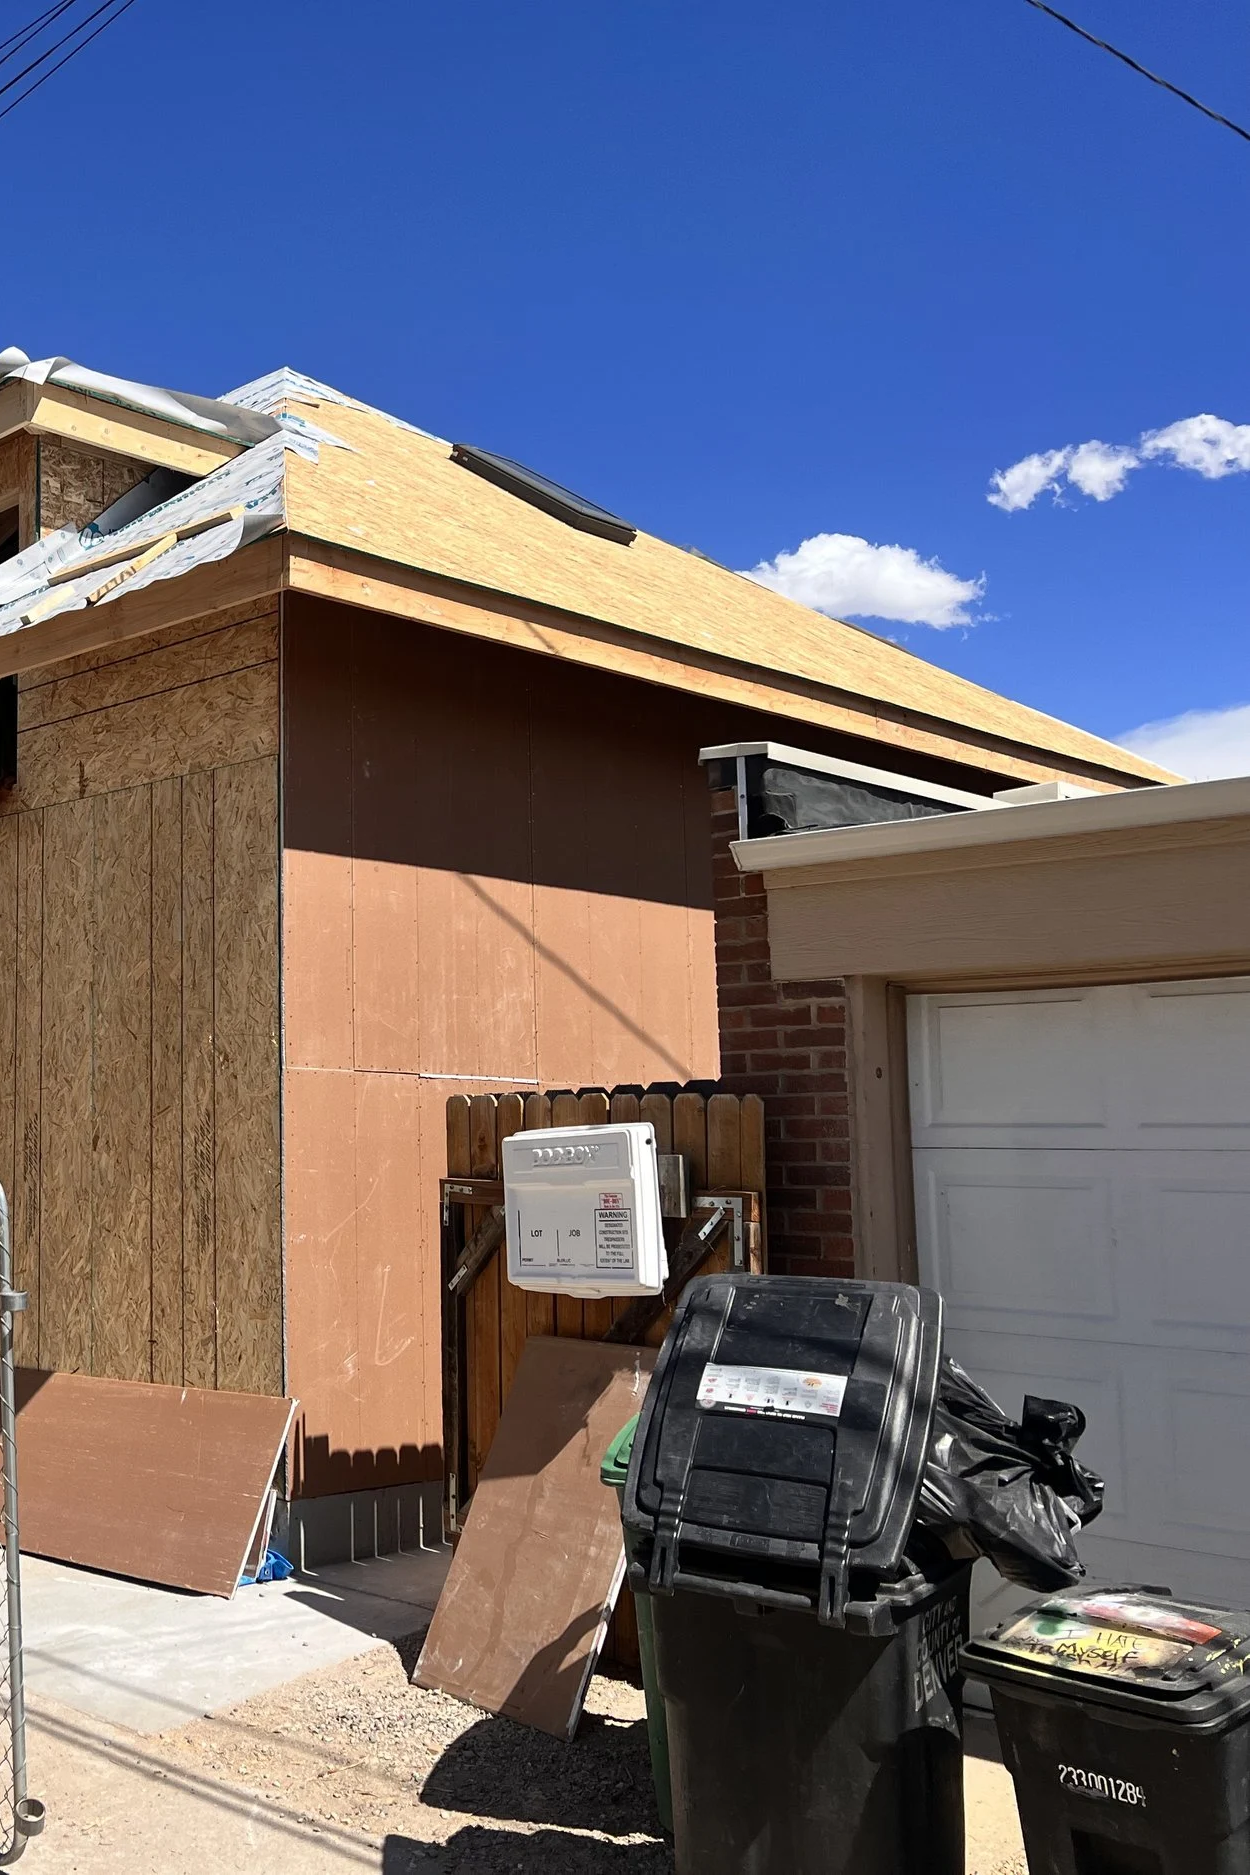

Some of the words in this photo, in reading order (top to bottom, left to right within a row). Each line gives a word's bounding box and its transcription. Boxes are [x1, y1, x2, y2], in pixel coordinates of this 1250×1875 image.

[599, 1211, 628, 1219] WARNING
[530, 1229, 543, 1238] LOT
[568, 1229, 581, 1237] JOB
[1096, 1631, 1147, 1648] HATE
[913, 1633, 963, 1713] DENVER
[1058, 1764, 1147, 1808] 233001284
